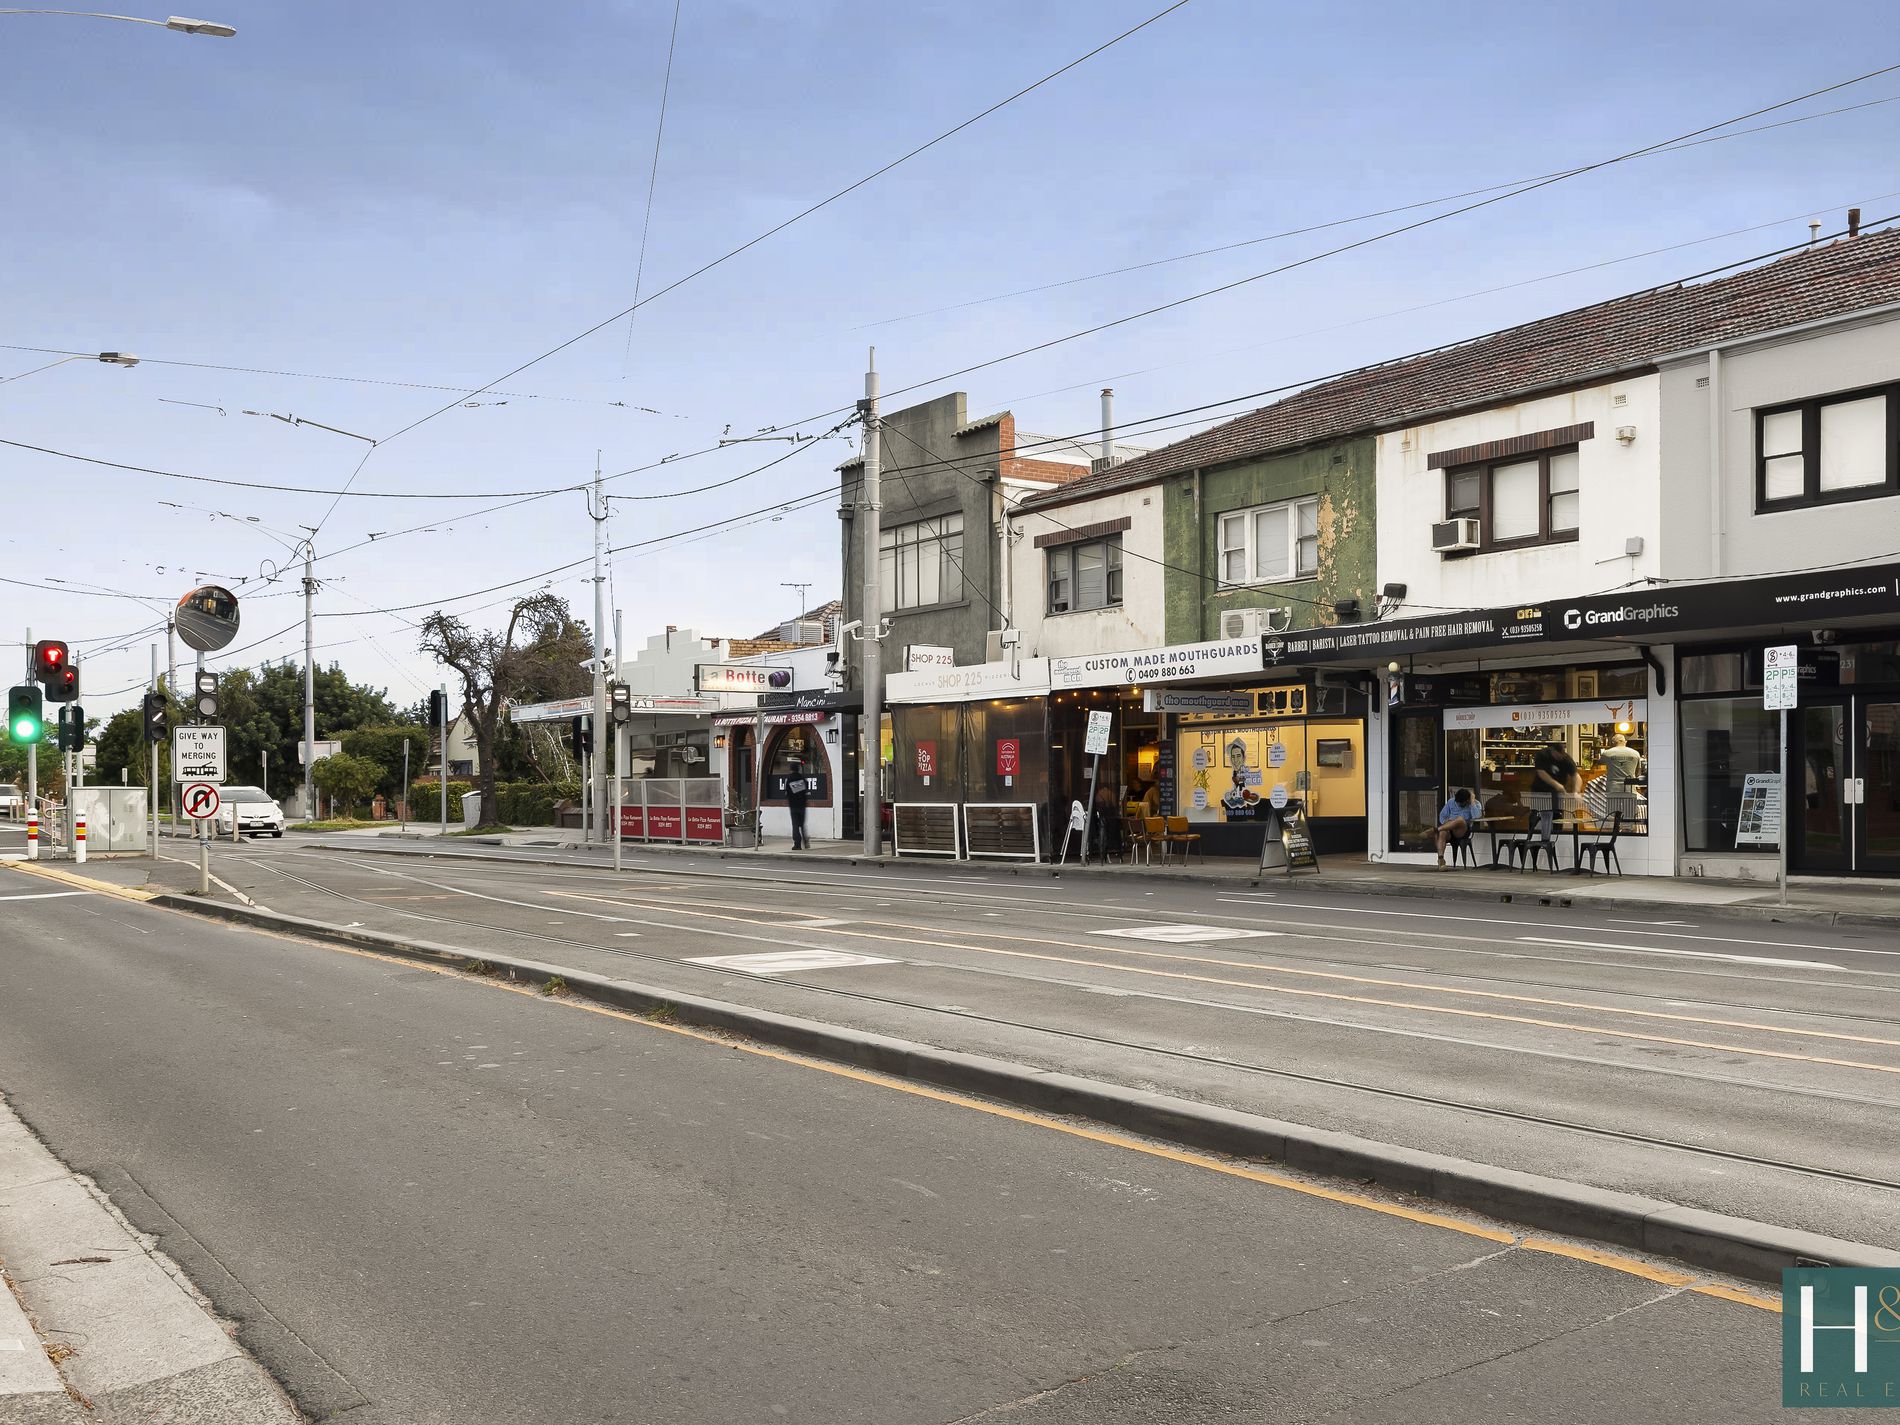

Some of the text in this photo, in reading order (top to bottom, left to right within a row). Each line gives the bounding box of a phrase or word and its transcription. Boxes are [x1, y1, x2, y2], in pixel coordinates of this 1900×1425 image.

[1775, 585, 1886, 603] www.grandgraphics.com
[1585, 604, 1679, 625] GrandGraphics
[1288, 640, 1308, 652] BARBER
[1312, 637, 1335, 650] BARISTA
[1340, 635, 1358, 648] LASER
[1358, 633, 1380, 646] TATTOO
[1380, 629, 1408, 642] REMOVAL
[1409, 629, 1414, 640] &
[1415, 627, 1430, 639] PAIN
[1431, 624, 1446, 638] FREE
[1448, 624, 1462, 636] HAIR
[1464, 620, 1494, 634] REMOVAL
[911, 654, 952, 664] SHOP 225
[1086, 658, 1129, 671] CUSTOM
[1134, 654, 1165, 666] MADE
[1169, 644, 1258, 662] MOUTHGUARDS
[701, 669, 766, 684] La Botte
[1138, 665, 1195, 679] 0409 880 663
[1766, 670, 1780, 680] 2P
[1798, 664, 1816, 675] raphics
[938, 674, 962, 688] SHOP
[964, 672, 982, 687] 225
[1164, 696, 1249, 708] the mouthguard man
